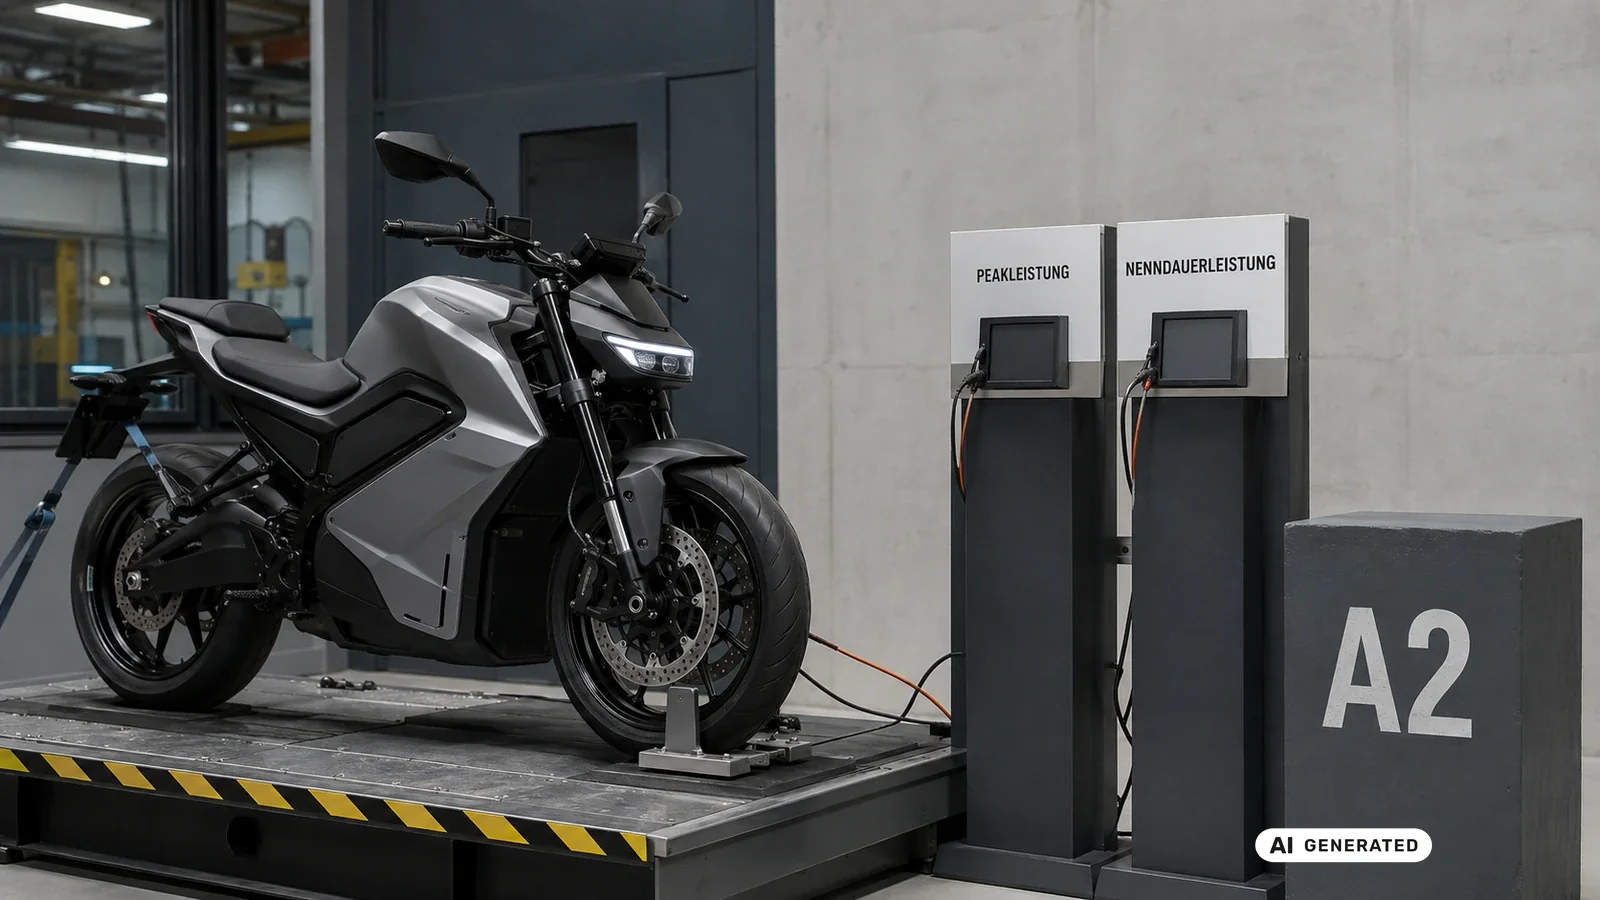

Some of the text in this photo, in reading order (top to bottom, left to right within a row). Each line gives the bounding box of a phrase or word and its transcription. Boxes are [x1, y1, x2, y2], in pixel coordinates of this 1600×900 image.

[976, 265, 1070, 284] PEAKLEISTUNG
[1125, 254, 1276, 277] NENNDAUERLEISTUNG
[1322, 606, 1473, 739] A2
